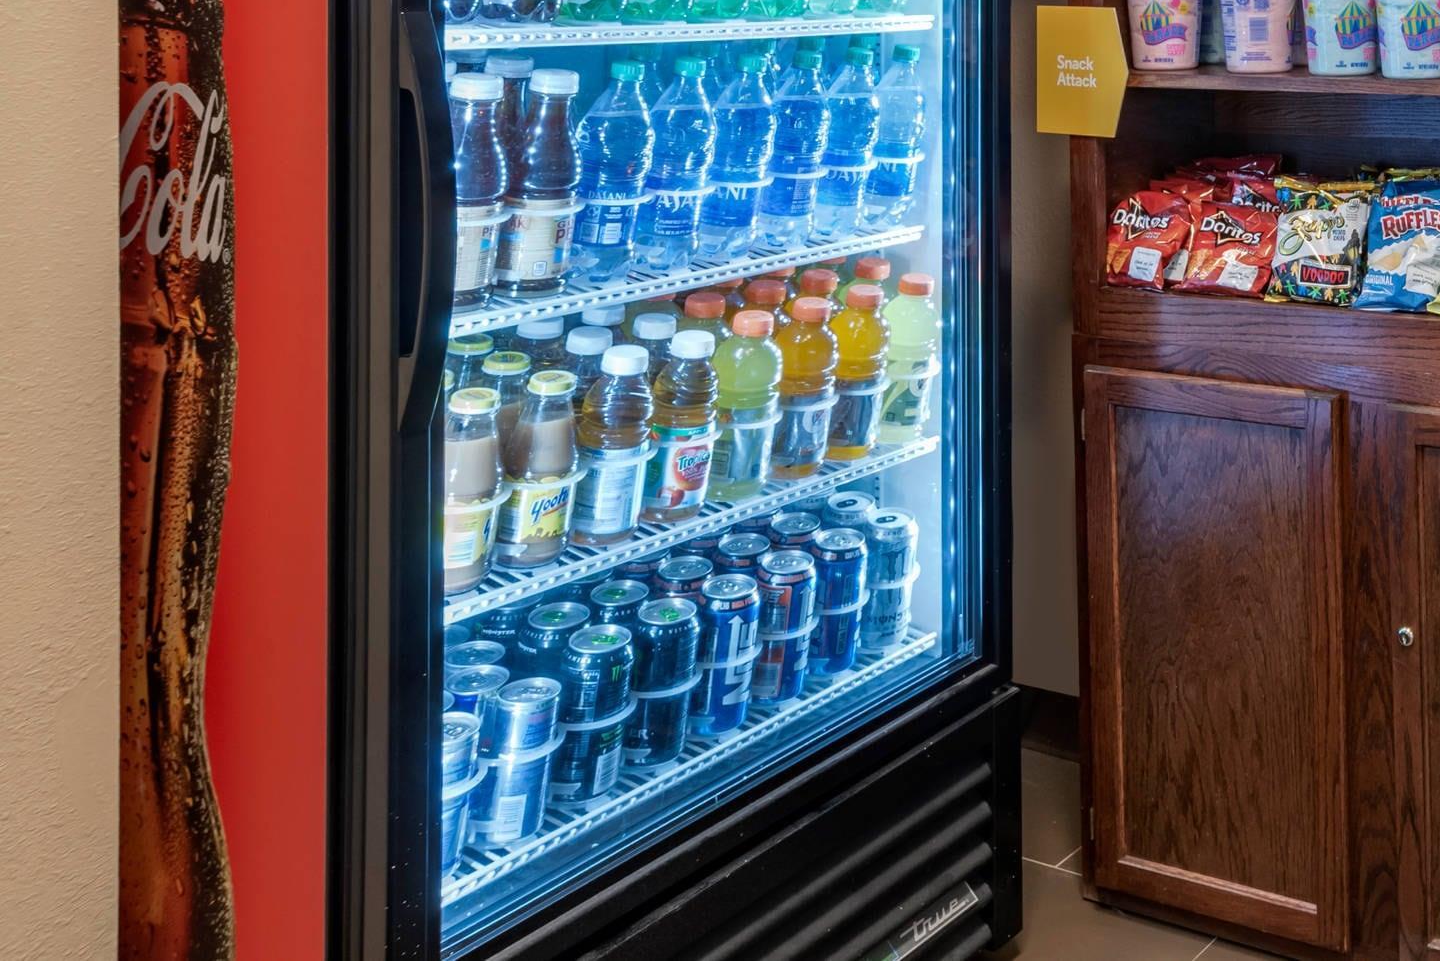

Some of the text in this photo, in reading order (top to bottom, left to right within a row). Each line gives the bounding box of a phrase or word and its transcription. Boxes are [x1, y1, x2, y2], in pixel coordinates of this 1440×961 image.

[1056, 54, 1094, 70] Snack
[1056, 73, 1097, 88] Attack
[1113, 208, 1170, 229] Doritos
[1200, 216, 1262, 244] Doritos
[1302, 266, 1345, 284] VOODOO
[1365, 274, 1393, 285] ORIGINAL
